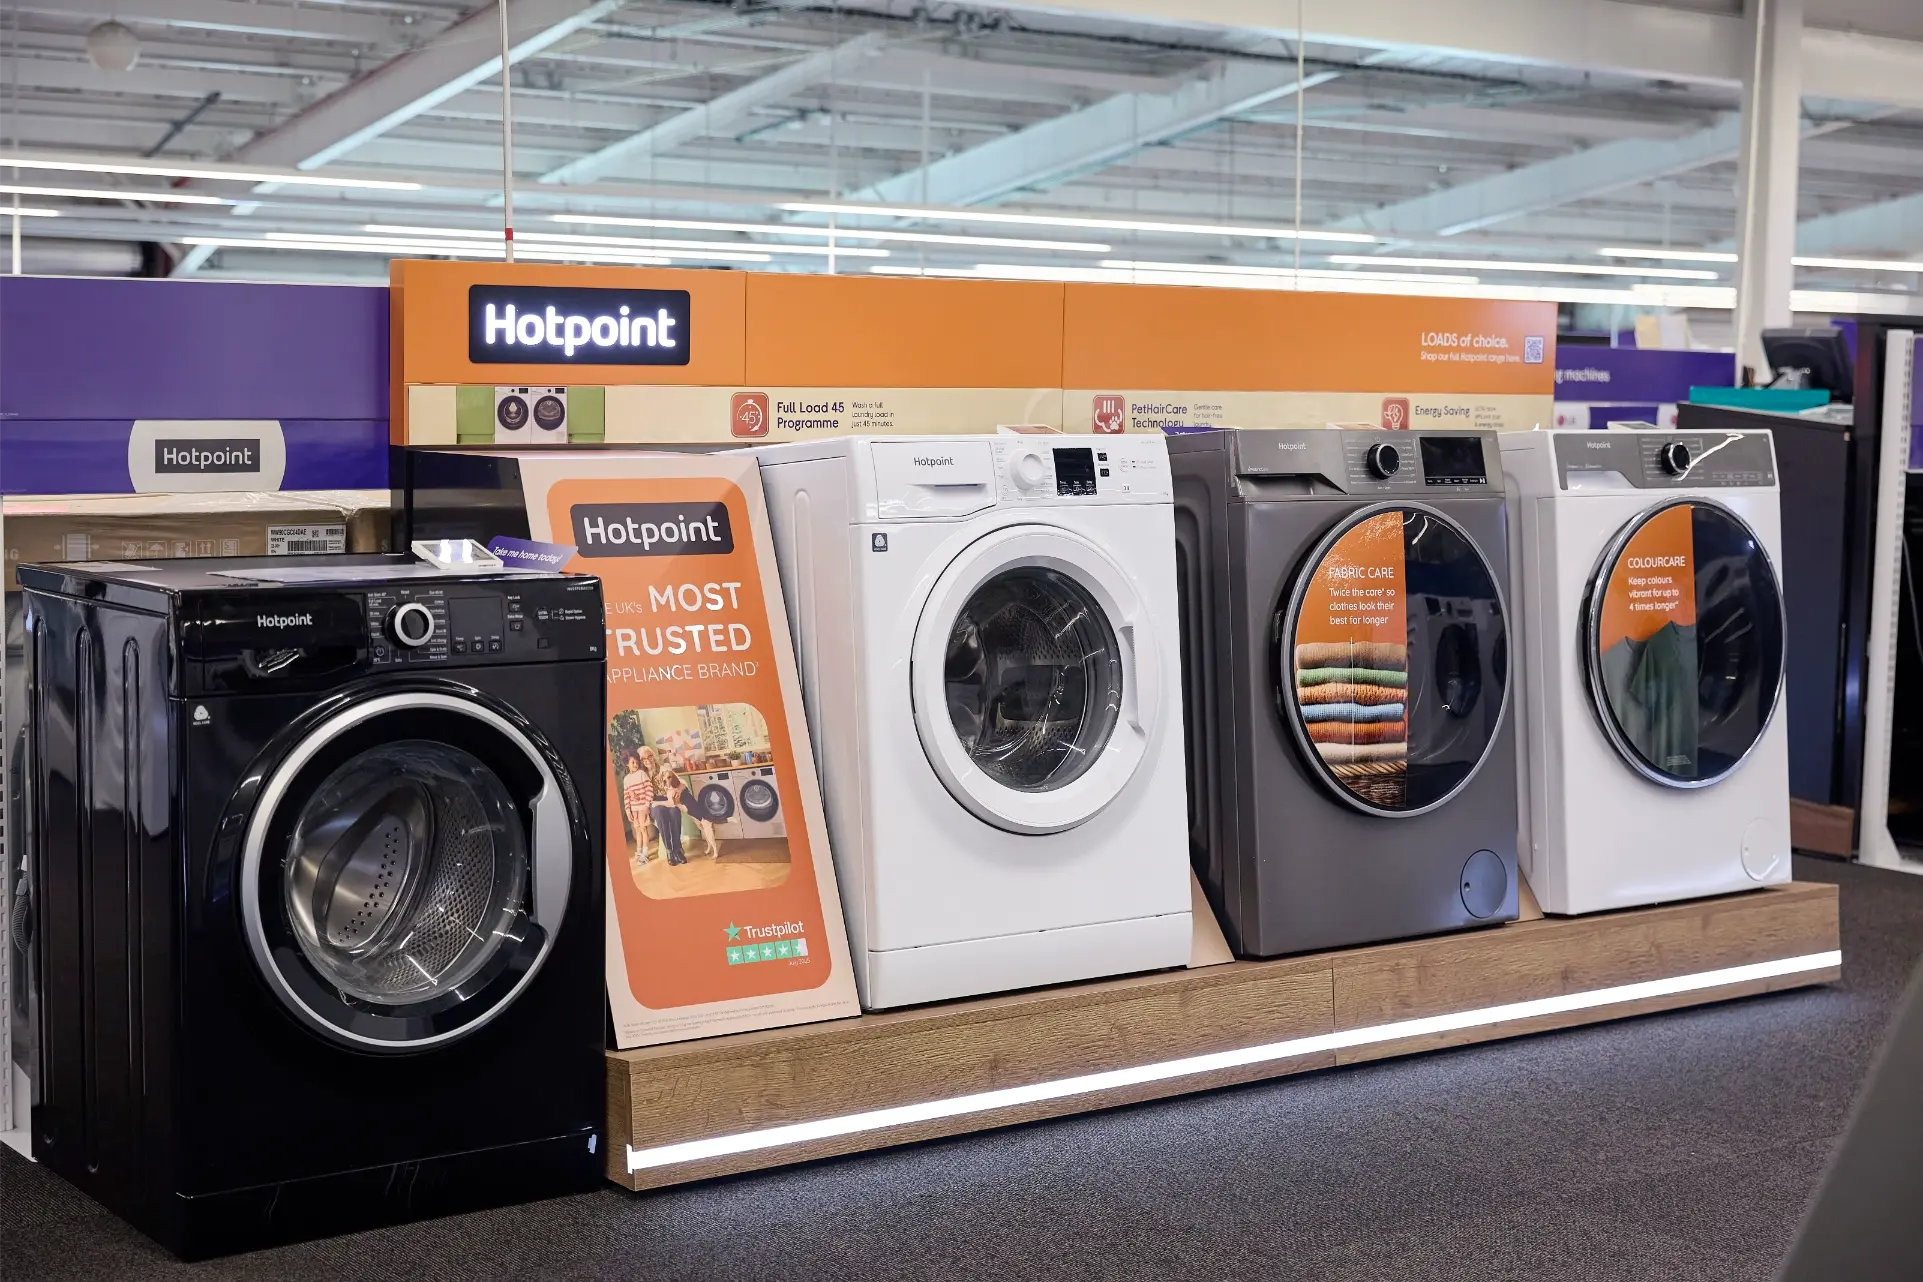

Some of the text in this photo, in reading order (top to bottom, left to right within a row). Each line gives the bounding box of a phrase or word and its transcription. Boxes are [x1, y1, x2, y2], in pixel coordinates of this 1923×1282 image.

[484, 303, 676, 357] Hotpoint
[1421, 332, 1509, 348] LOADS of choice.
[1420, 351, 1437, 361] Shop
[1438, 353, 1449, 361] our
[1449, 352, 1459, 361] full
[1460, 352, 1488, 362] Hotpoint
[1488, 354, 1505, 364] range
[1564, 366, 1610, 383] machines
[777, 401, 845, 413] Full Load 45
[1131, 403, 1188, 415] PetHairCare
[1415, 405, 1442, 418] Energy
[1443, 405, 1470, 418] Saving
[851, 411, 874, 419] laundry
[777, 417, 839, 431] Programme
[851, 420, 861, 429] just
[1131, 417, 1184, 428] Technology
[1278, 442, 1307, 452] Hotpoint
[1586, 441, 1611, 449] Hotpoint
[162, 446, 252, 469] Hotpoint
[914, 456, 955, 468] Hotpoint
[583, 515, 722, 551] Hotpoint
[492, 546, 562, 565] Take me home today!
[1627, 556, 1686, 569] COLOURCARE
[1328, 567, 1395, 579] FABRIC CARE
[1628, 575, 1673, 587] Keep colours
[615, 602, 643, 614] UK's
[648, 582, 742, 613] MOST
[1328, 587, 1351, 597] Twice
[1351, 587, 1365, 597] the
[1386, 589, 1396, 597] so
[1628, 588, 1680, 598] vibrant for up to
[1329, 601, 1395, 611] clothes look their
[1629, 602, 1634, 611] 4
[1635, 601, 1654, 611] times
[256, 612, 313, 629] Hotpoint
[1329, 615, 1389, 627] best for longer
[743, 920, 805, 938] Trustpilot
